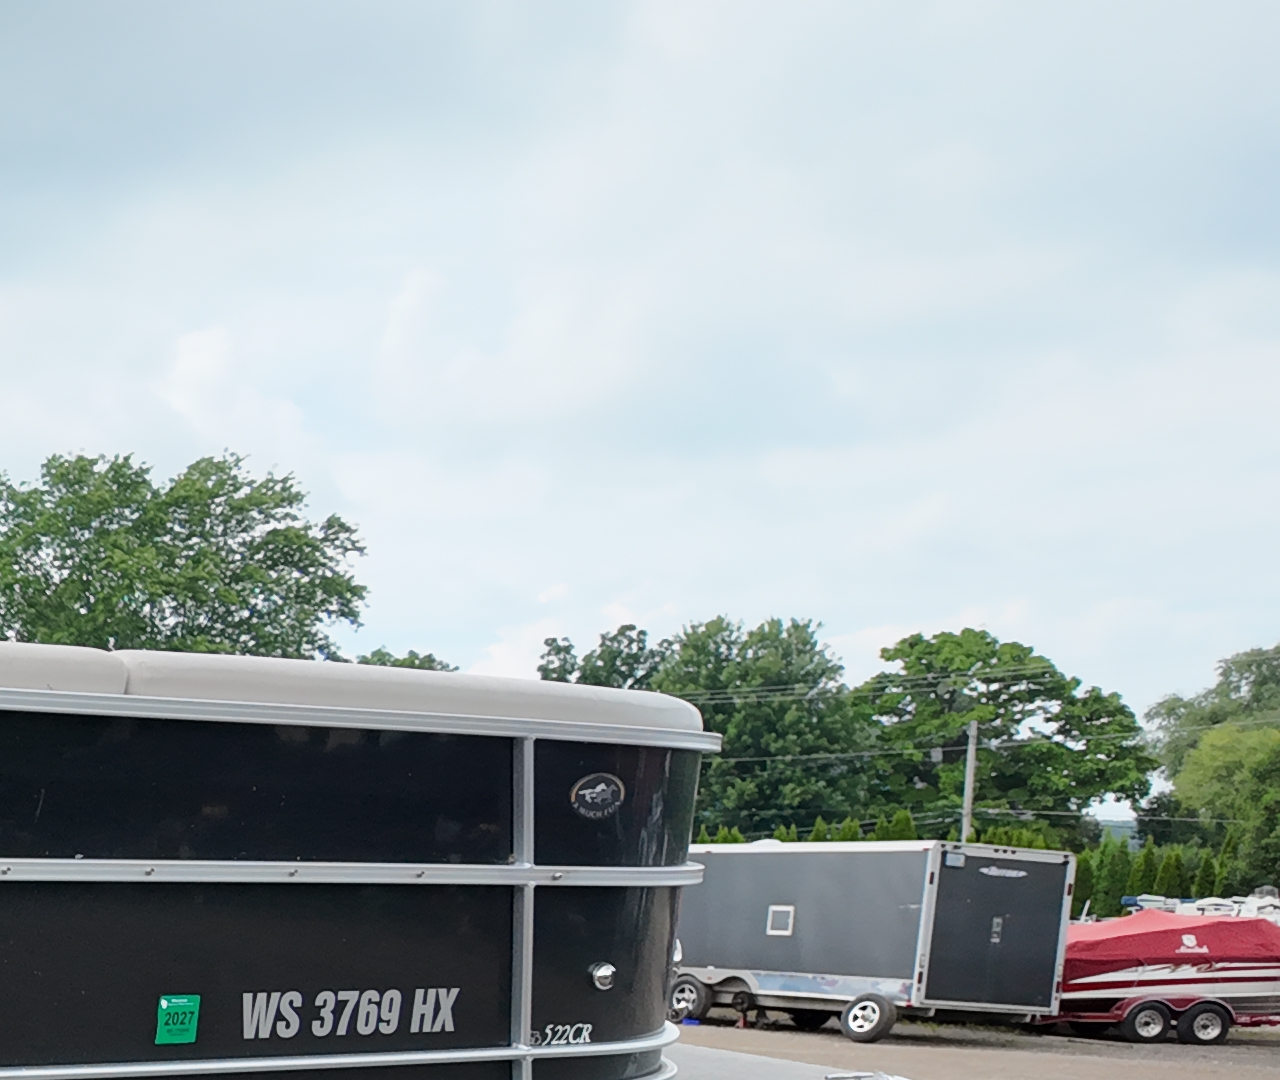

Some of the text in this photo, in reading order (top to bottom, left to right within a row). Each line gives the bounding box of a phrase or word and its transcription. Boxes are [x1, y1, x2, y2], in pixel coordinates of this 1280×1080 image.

[164, 1010, 195, 1027] 2027
[242, 987, 461, 1040] WS 3769 HX
[541, 1022, 593, 1047] 522CR
